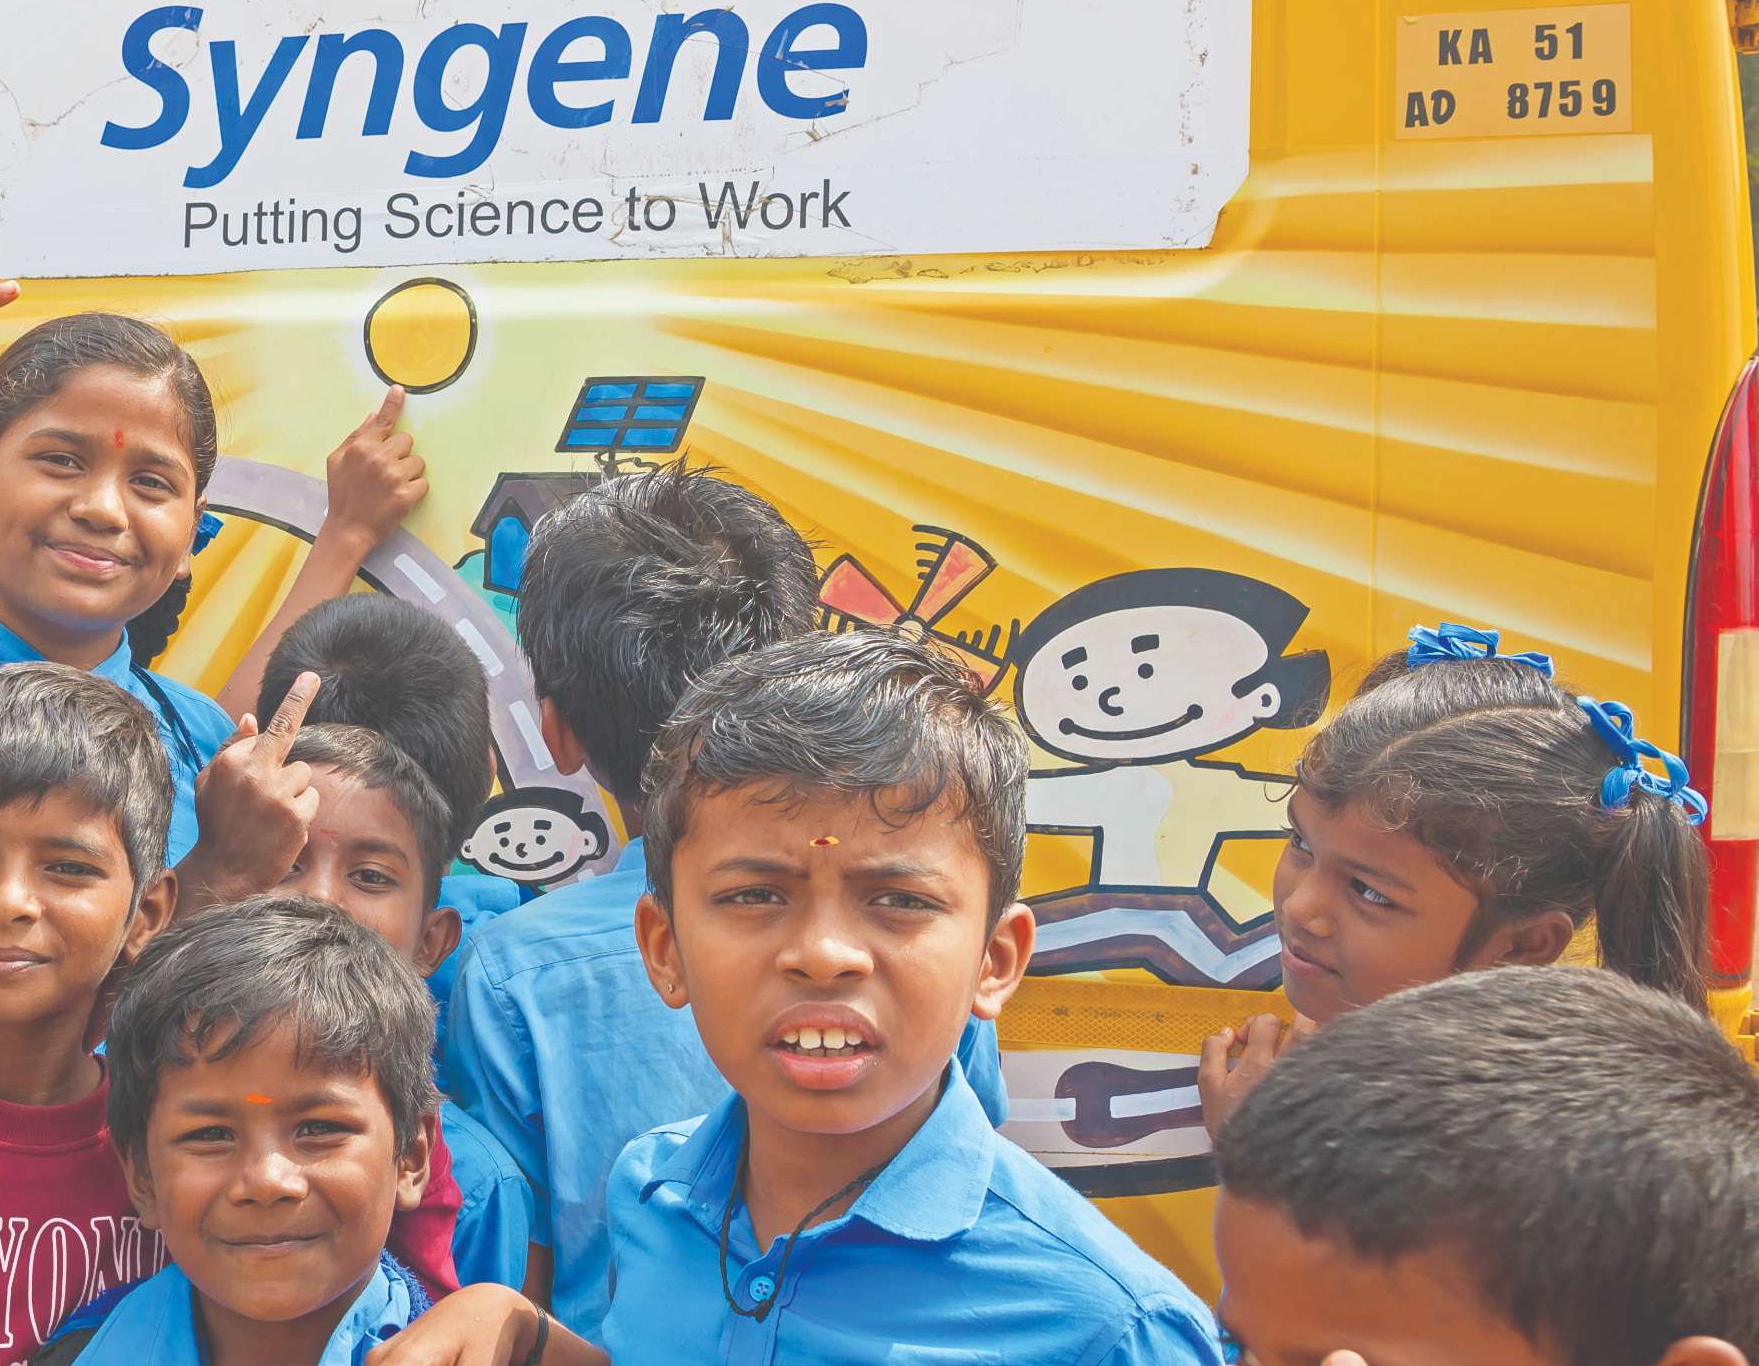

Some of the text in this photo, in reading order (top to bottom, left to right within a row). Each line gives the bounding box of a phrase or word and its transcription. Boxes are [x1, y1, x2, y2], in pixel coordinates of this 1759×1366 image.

[1437, 21, 1584, 66] KA 51
[100, 2, 869, 189] Syngene
[1404, 78, 1617, 128] AD 8759
[182, 178, 851, 253] Putting Science to Work
